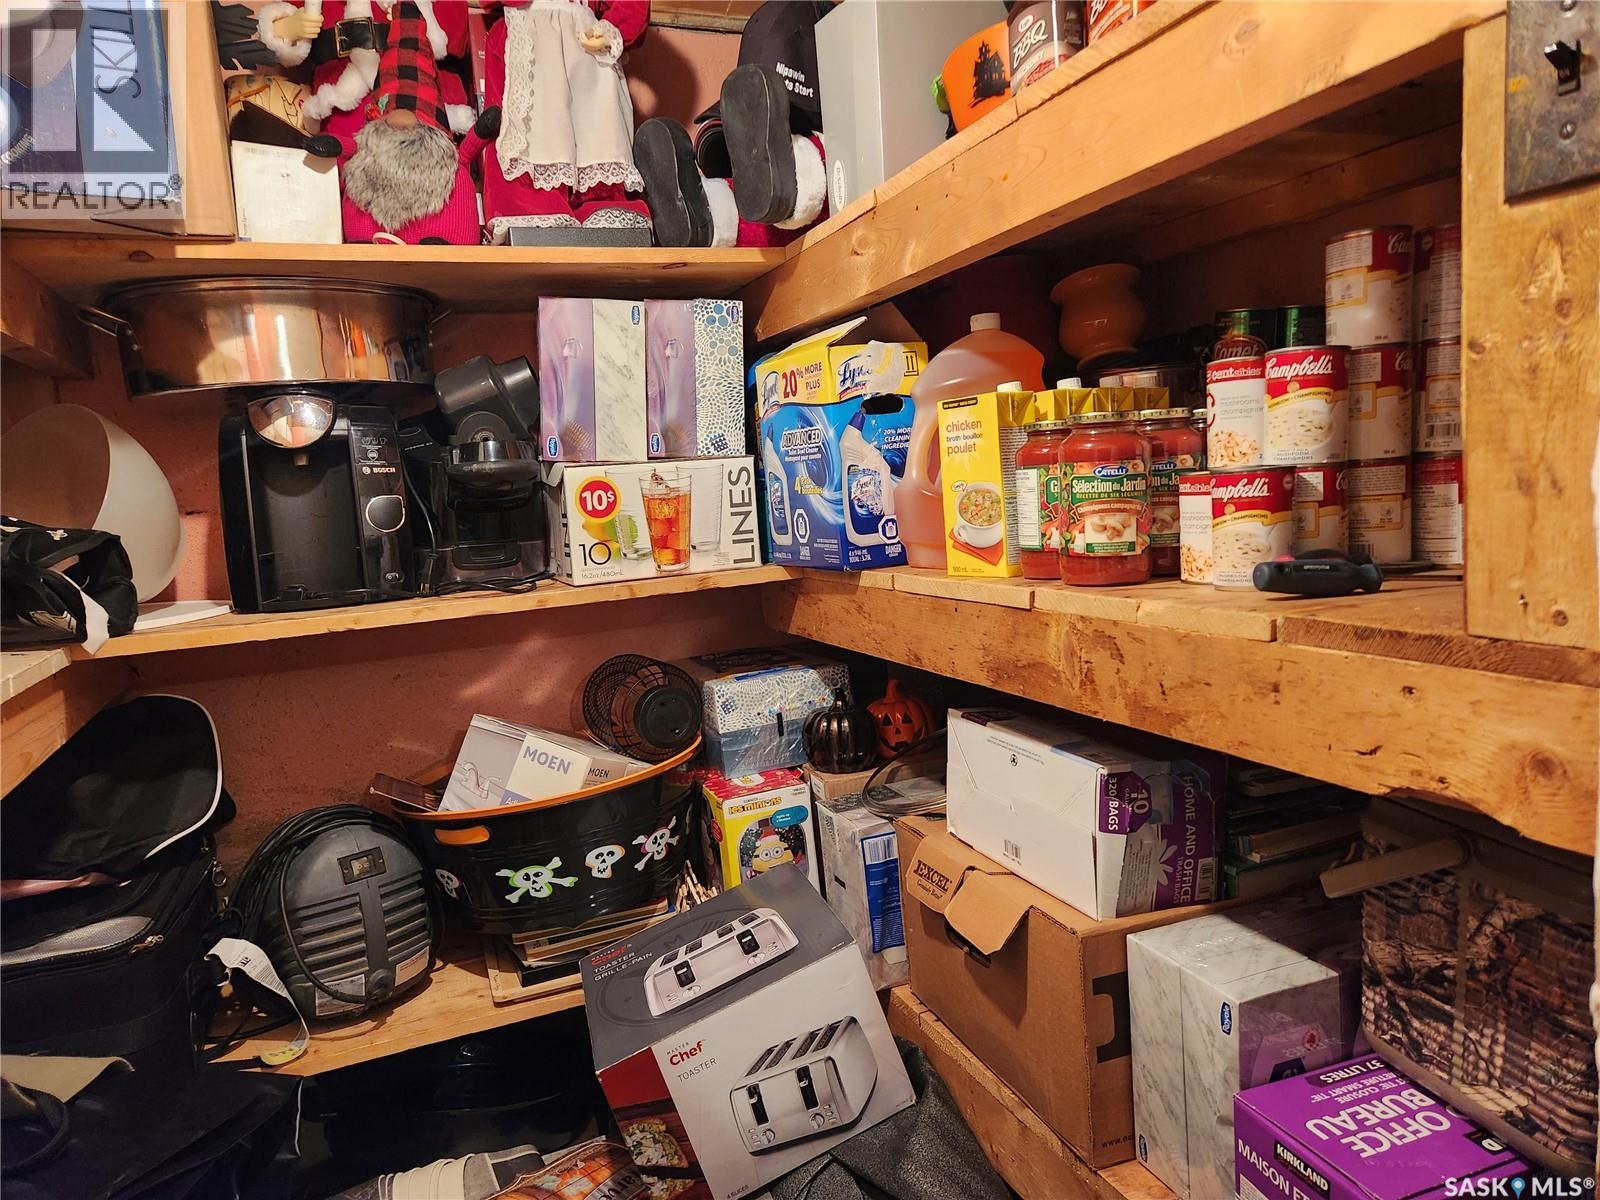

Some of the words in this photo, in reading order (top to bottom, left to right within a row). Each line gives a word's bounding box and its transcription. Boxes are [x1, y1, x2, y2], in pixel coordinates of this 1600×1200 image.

[1013, 19, 1048, 69] BBQ
[776, 62, 805, 83] Nipawin
[794, 82, 814, 98] Start
[731, 306, 739, 324] Royale
[805, 362, 822, 374] MORE
[1265, 355, 1333, 382] Campbell's
[806, 379, 821, 390] PLUS
[896, 426, 912, 434] MOR
[946, 419, 982, 433] chicken
[651, 435, 659, 451] Royale
[782, 428, 821, 449] ADVANCED
[881, 442, 910, 450] INGREDIE
[884, 433, 910, 443] CLEANIN
[947, 441, 977, 456] poulet
[1094, 467, 1128, 475] CATELLI
[795, 476, 801, 494] 4
[1072, 479, 1113, 493] Sélection
[1113, 482, 1121, 490] du
[1121, 477, 1146, 492] Jardin
[1210, 476, 1270, 502] Campbell's
[728, 465, 756, 564] LINES
[579, 542, 611, 566] 10
[885, 544, 902, 554] DANGER
[523, 745, 571, 775] MOEN
[588, 767, 610, 778] MOEN
[1108, 777, 1118, 797] 320
[728, 805, 744, 815] les
[744, 796, 783, 811] minions
[1133, 788, 1149, 814] 10
[1183, 776, 1197, 820] HOME
[1108, 800, 1119, 831] BAGS
[1185, 824, 1197, 856] AND
[913, 859, 951, 892] EXCEL
[1180, 859, 1195, 903] OFFICE
[593, 952, 635, 974] TOASTER
[594, 952, 653, 981] GRILLE-PAIN
[1222, 1004, 1231, 1033] Royale
[669, 1041, 702, 1066] Chef
[677, 1057, 717, 1083] TOASTER
[1319, 1063, 1366, 1084] LITRES
[1365, 1059, 1385, 1073] 37
[1334, 1085, 1378, 1104] CLOSURE
[1305, 1088, 1436, 1140] BUREAU
[1340, 1110, 1451, 1159] OFFICE
[1238, 1139, 1291, 1195] MAISON
[1276, 1143, 1329, 1193] KIRKLAND
